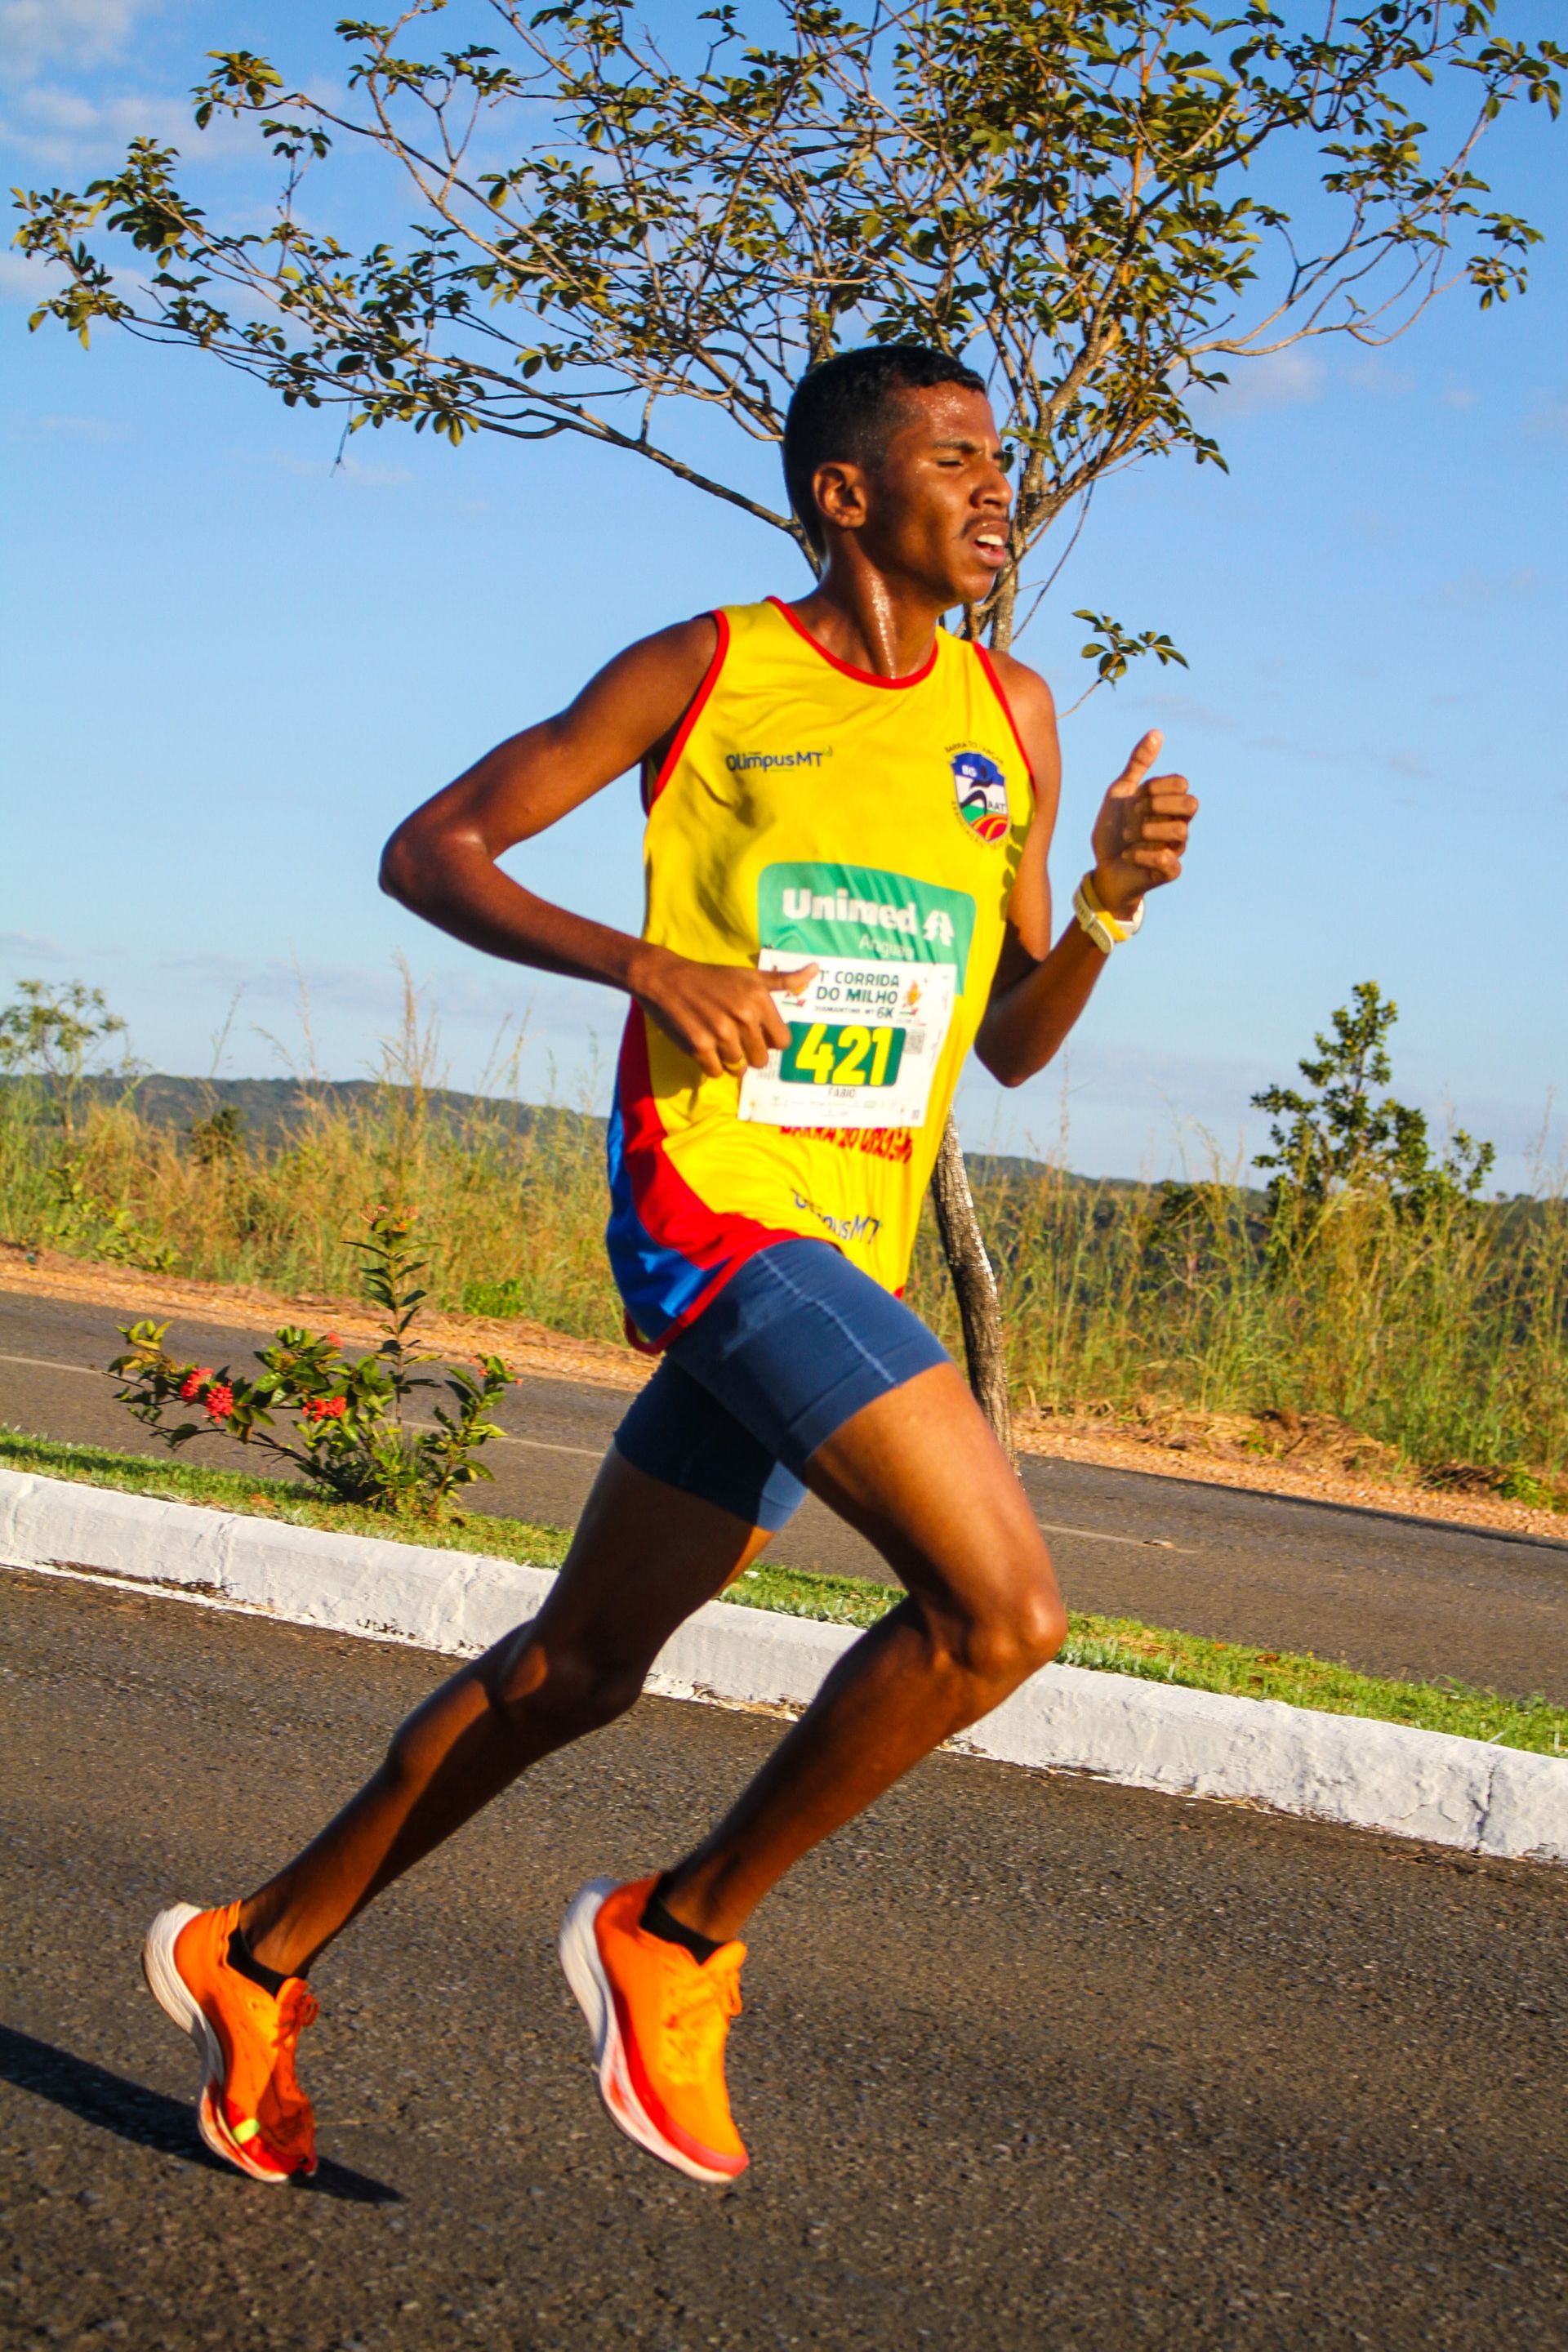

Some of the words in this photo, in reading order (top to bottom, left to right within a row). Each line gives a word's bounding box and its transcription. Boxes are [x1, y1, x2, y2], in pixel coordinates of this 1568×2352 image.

[782, 887, 918, 936] Unimed
[816, 986, 840, 1001] DO
[844, 987, 898, 1005] MILHO
[834, 970, 900, 987] CORRIDA
[794, 1022, 894, 1087] 421
